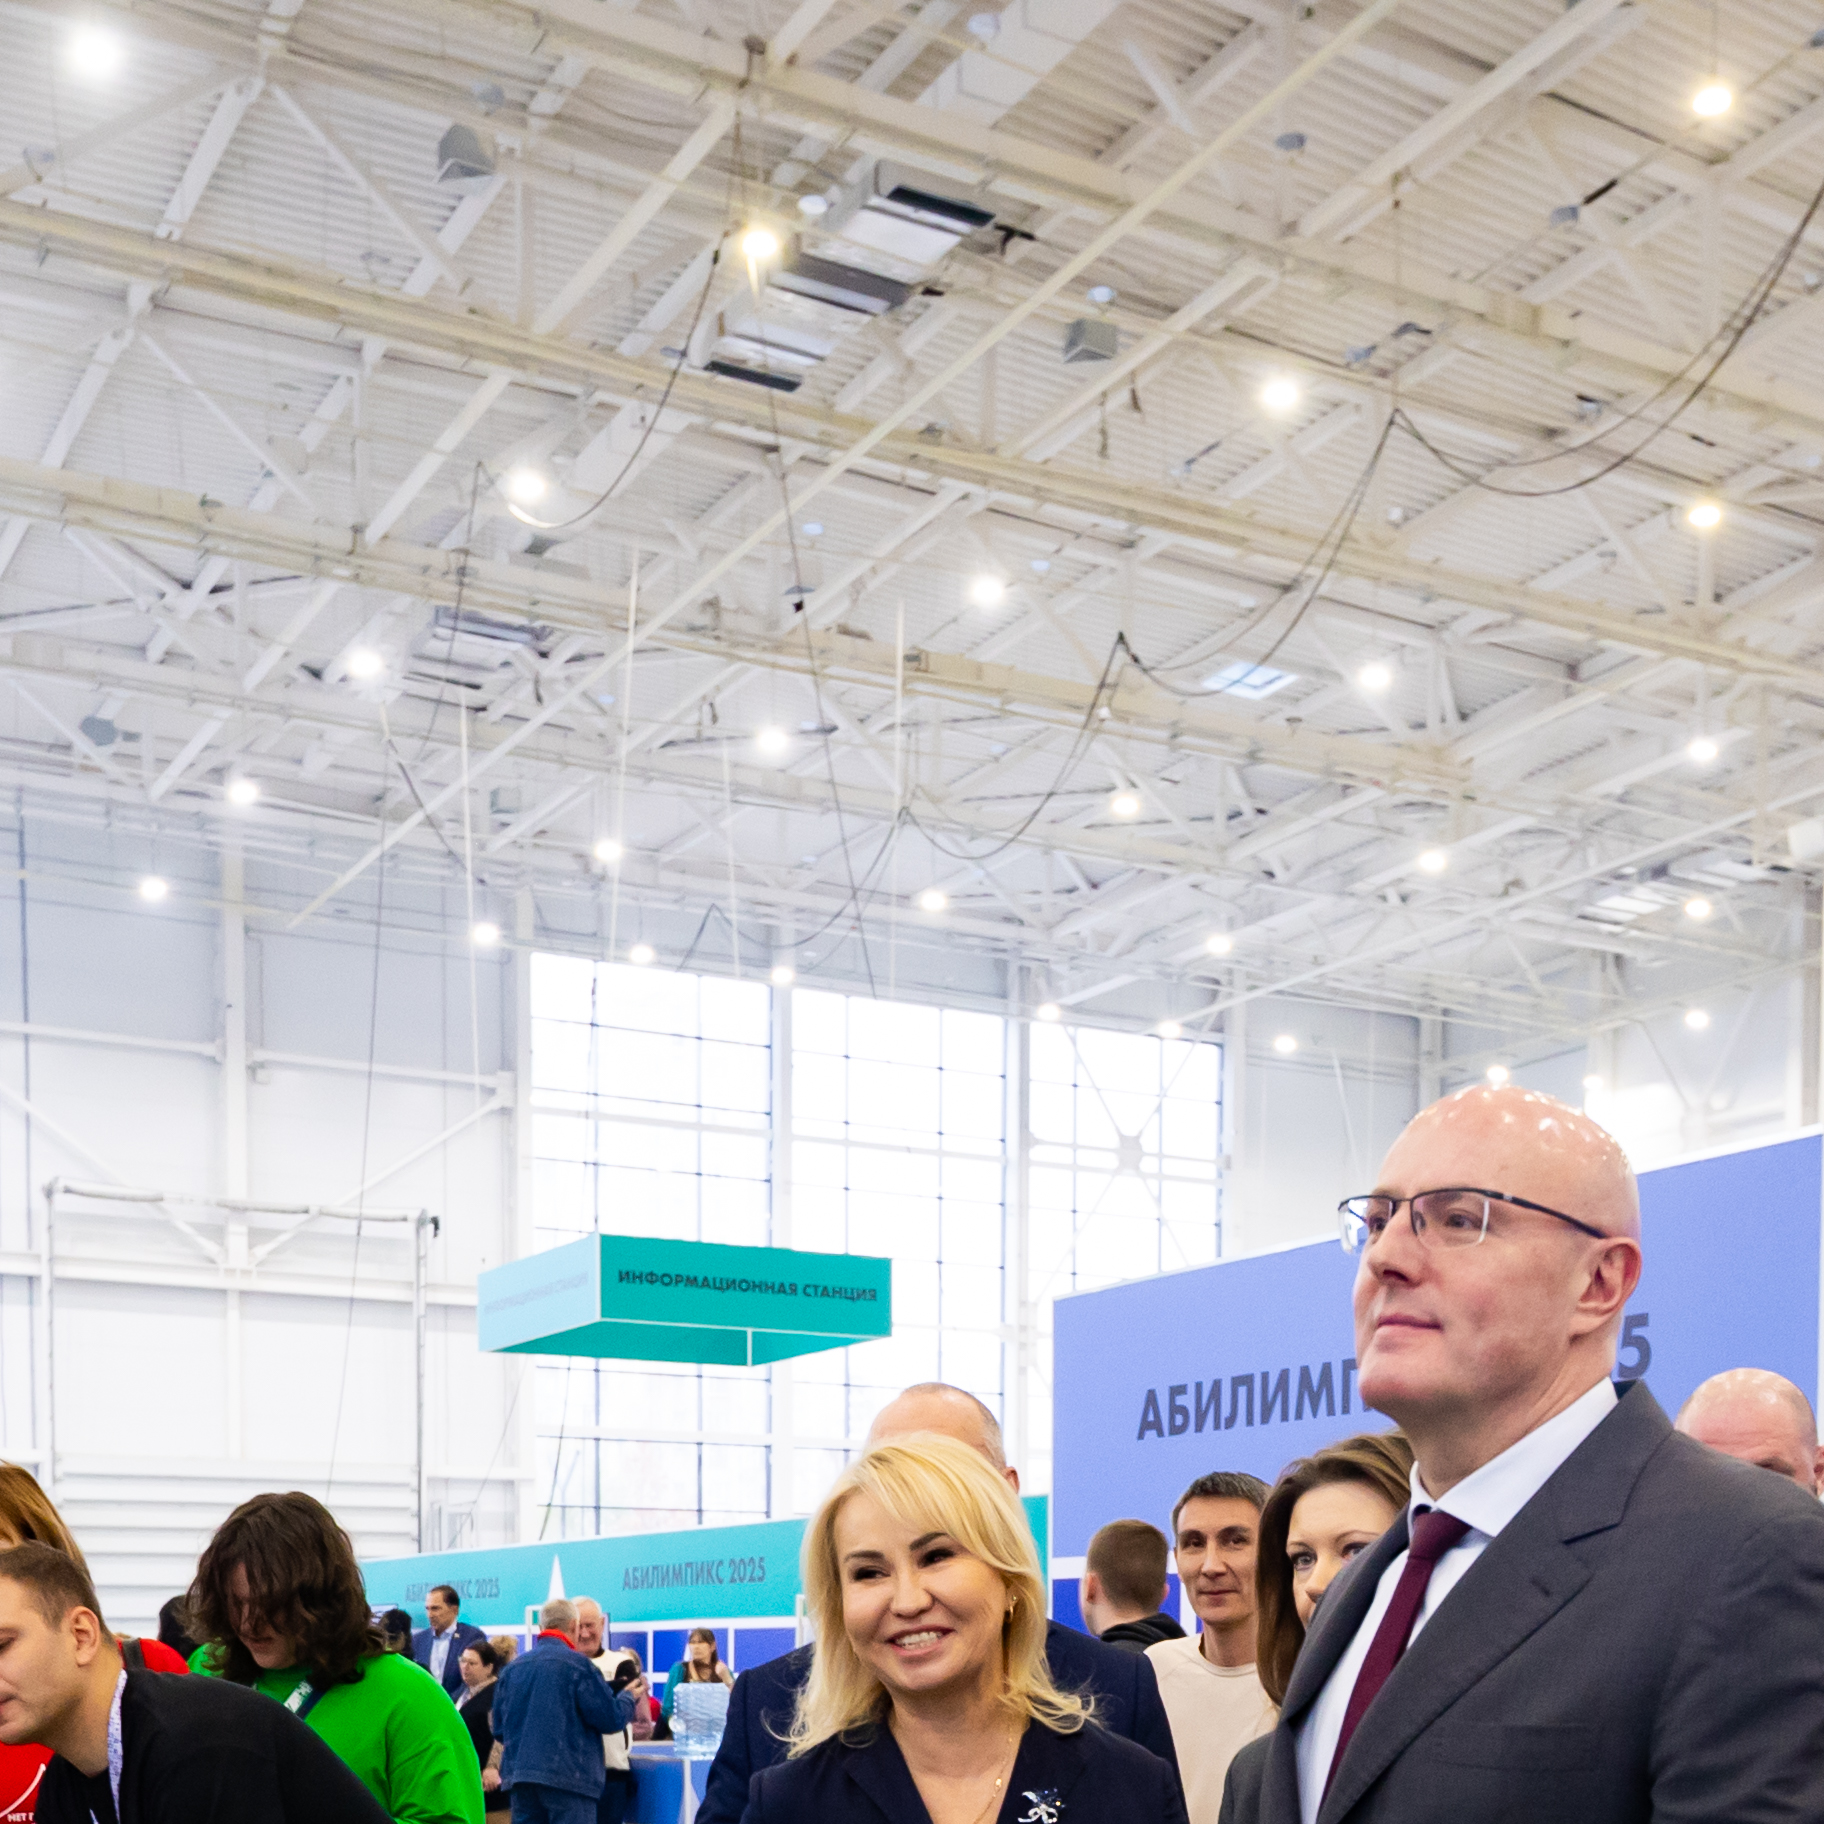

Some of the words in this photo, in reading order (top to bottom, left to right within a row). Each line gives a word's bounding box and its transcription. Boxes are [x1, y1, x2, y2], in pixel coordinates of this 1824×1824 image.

[618, 1269, 798, 1296] ИНФОРМАЦИОННАЯ
[803, 1284, 877, 1302] СТАНЦИЯ
[1136, 1359, 1372, 1441] АБИЛИМП
[622, 1560, 724, 1590] АБИЛИМПИКС
[728, 1556, 766, 1584] 2025
